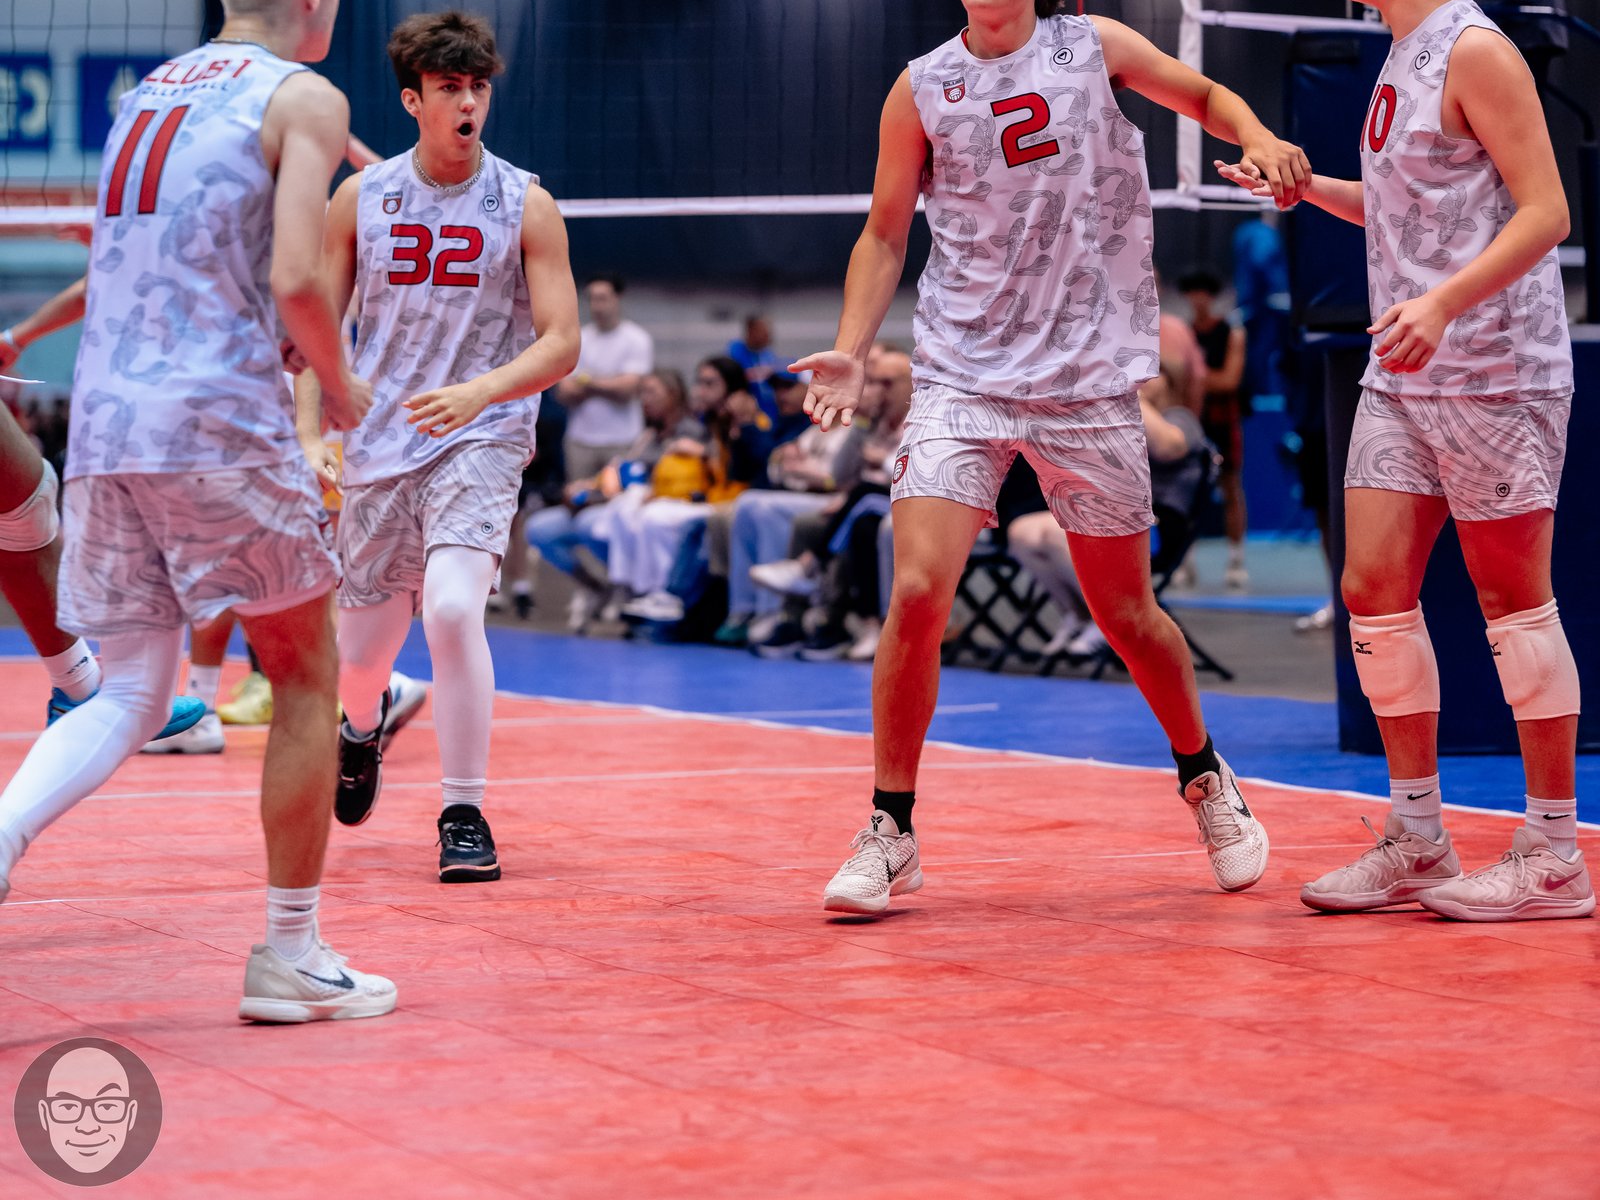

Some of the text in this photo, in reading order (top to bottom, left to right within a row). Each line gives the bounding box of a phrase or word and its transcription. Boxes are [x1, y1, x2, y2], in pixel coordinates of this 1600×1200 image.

[105, 103, 192, 217] 11
[990, 92, 1060, 168] 2
[388, 223, 484, 288] 32
